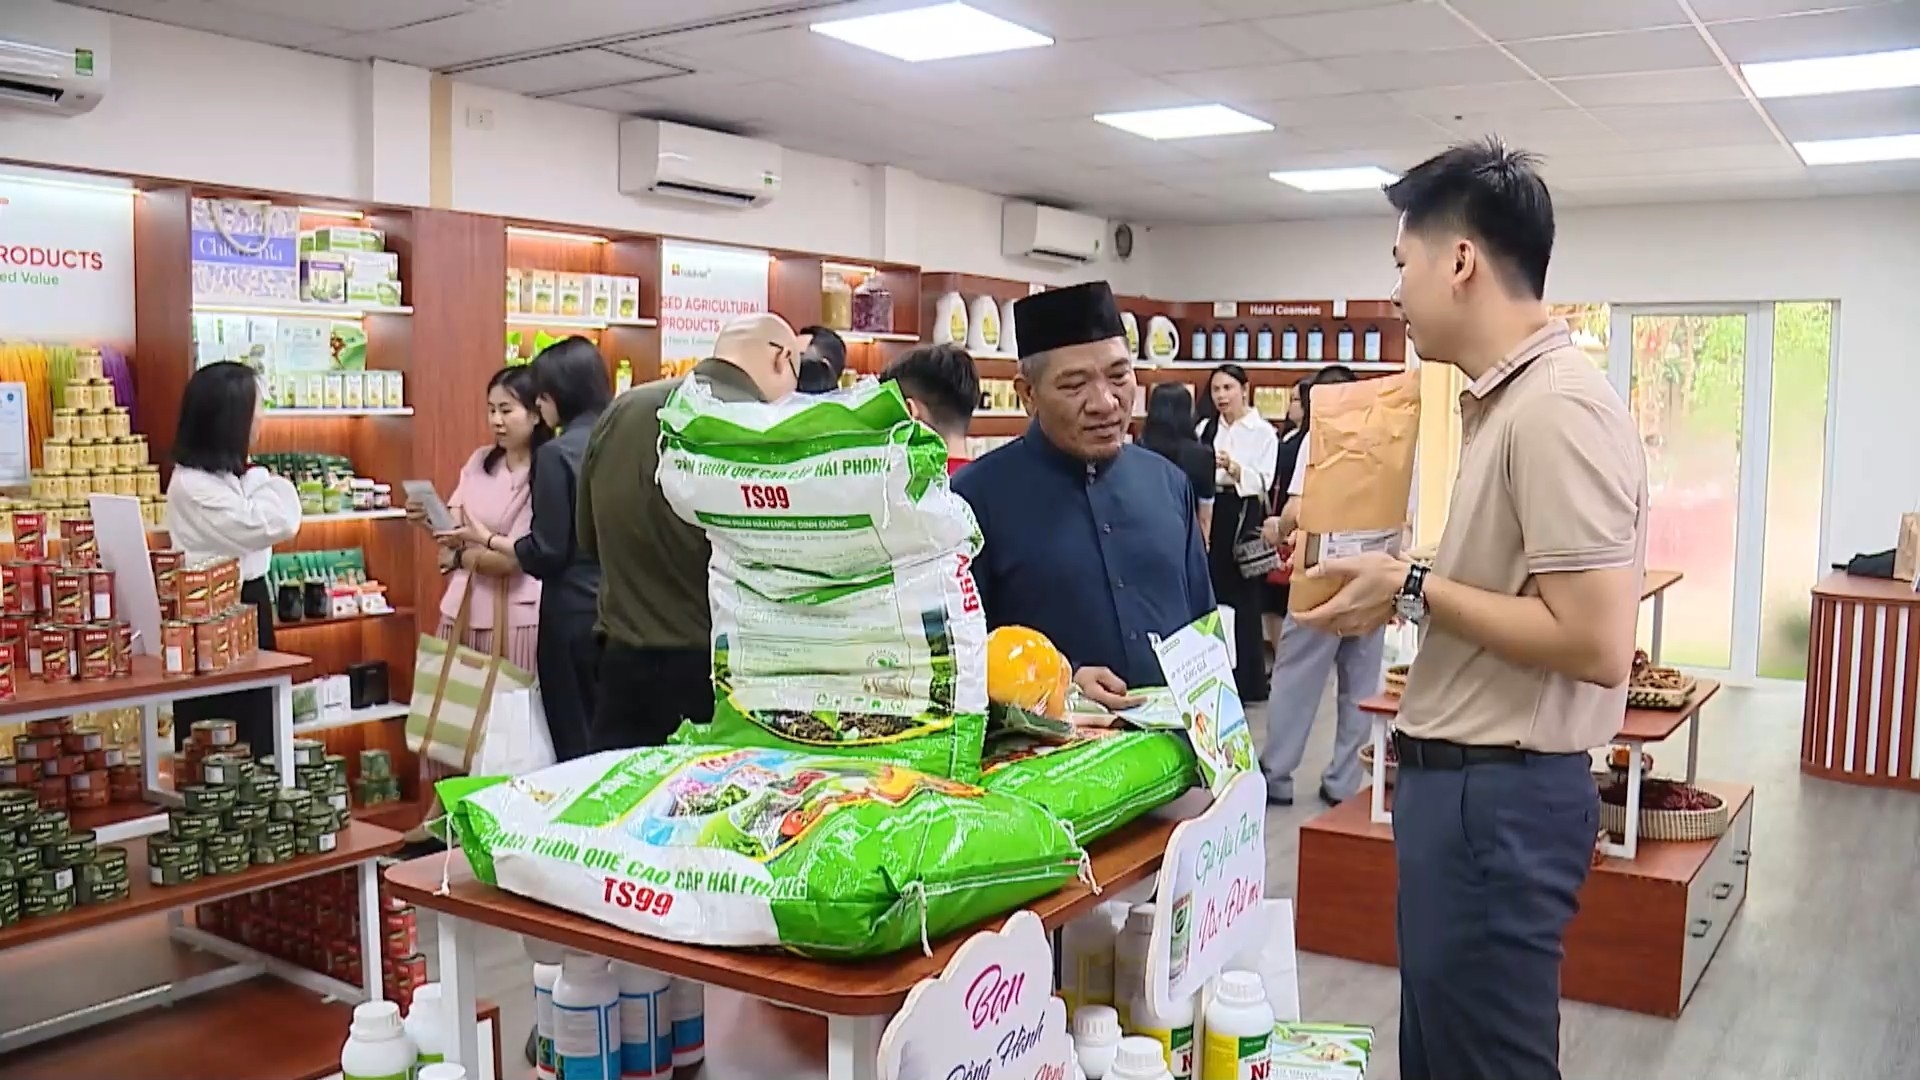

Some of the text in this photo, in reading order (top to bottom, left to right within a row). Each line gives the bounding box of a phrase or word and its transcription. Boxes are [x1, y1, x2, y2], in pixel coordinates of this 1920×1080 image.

[0, 245, 104, 272] RODUCTS
[21, 271, 61, 286] Value
[1249, 303, 1322, 316] Halal Cosmetic
[661, 315, 721, 334] PRODUCTS
[740, 484, 791, 511] TS99
[625, 860, 672, 886] CAO
[603, 877, 676, 918] TS99
[965, 964, 1025, 1031] Bạn
